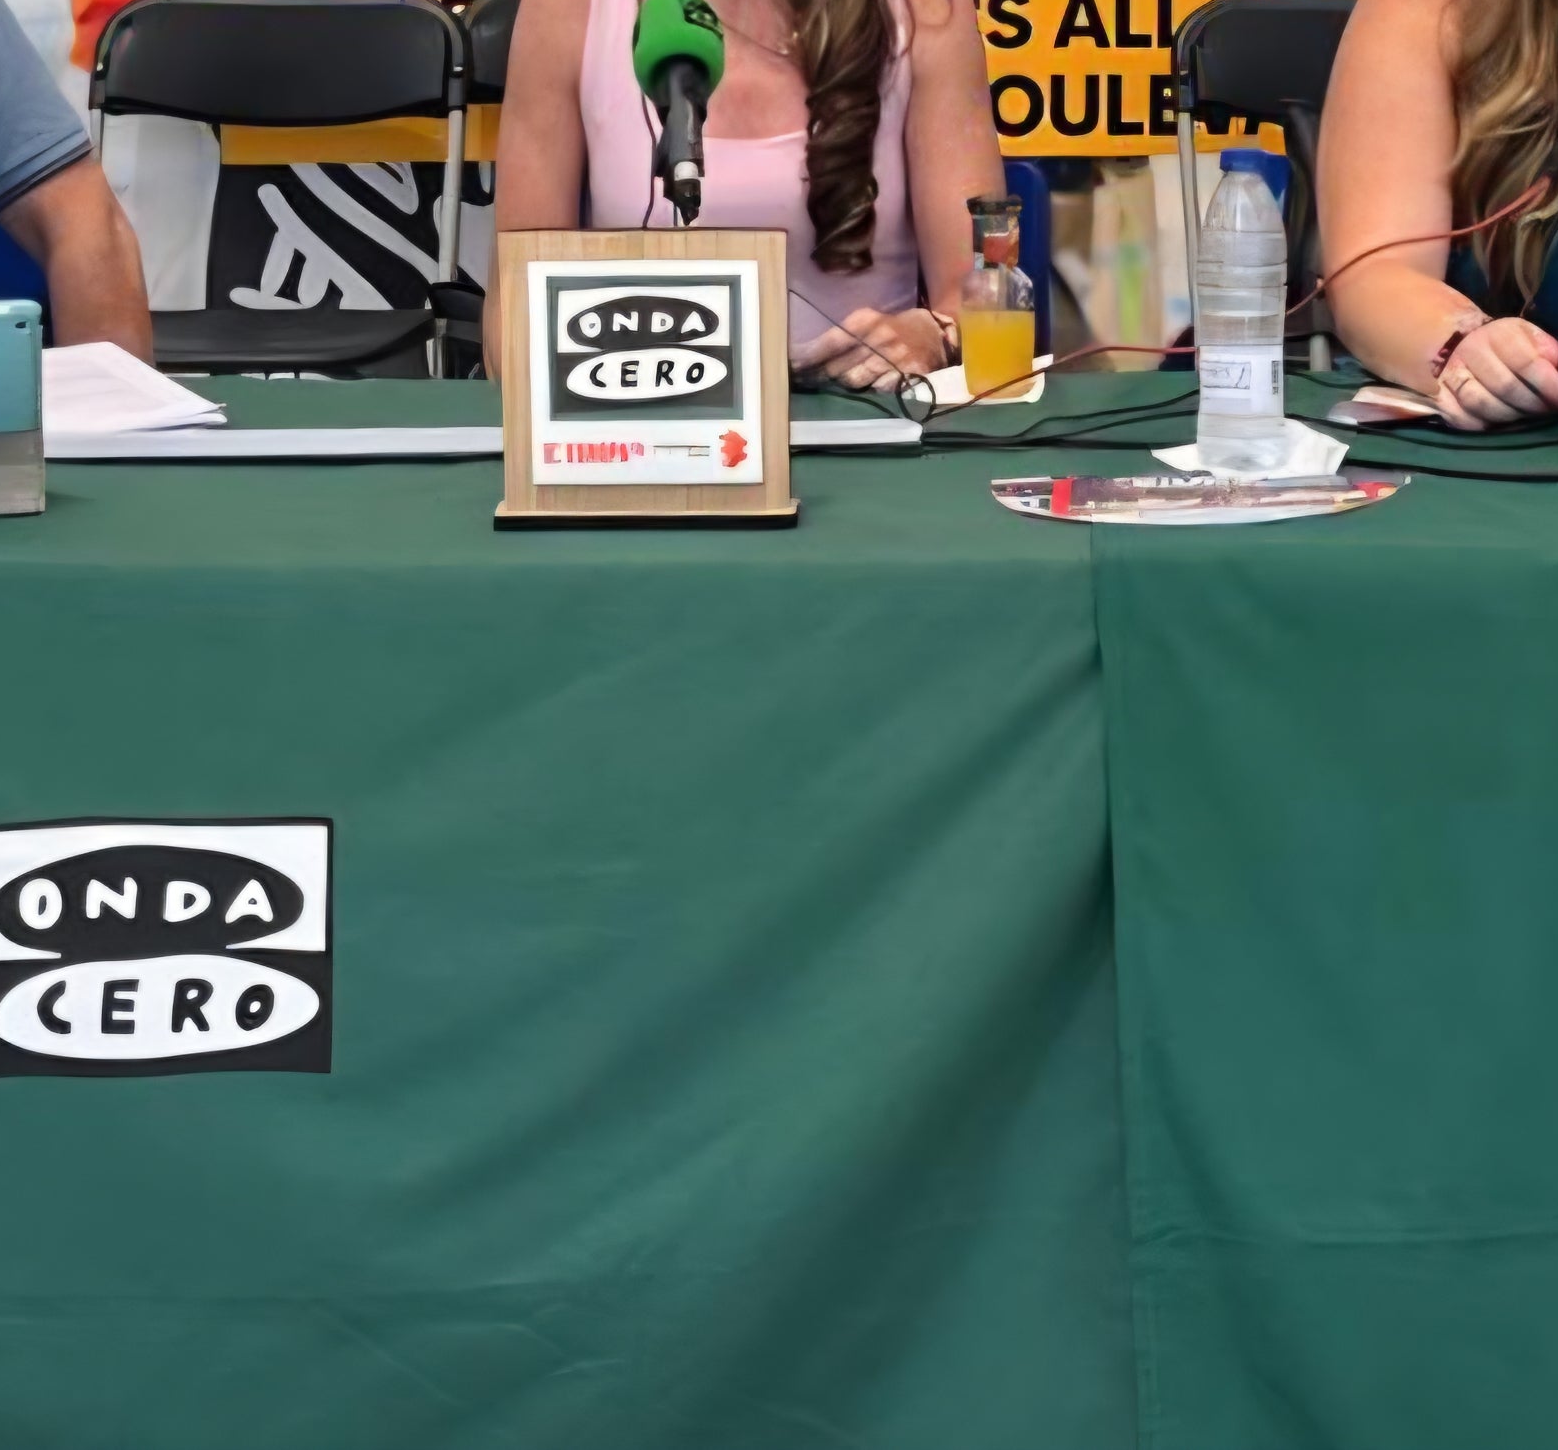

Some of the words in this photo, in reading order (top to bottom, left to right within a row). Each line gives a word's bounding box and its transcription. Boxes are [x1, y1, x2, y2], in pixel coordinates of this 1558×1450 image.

[579, 310, 706, 337] ONDA
[590, 359, 705, 388] CERO
[19, 877, 273, 930] ONDA
[37, 978, 274, 1035] CERO
